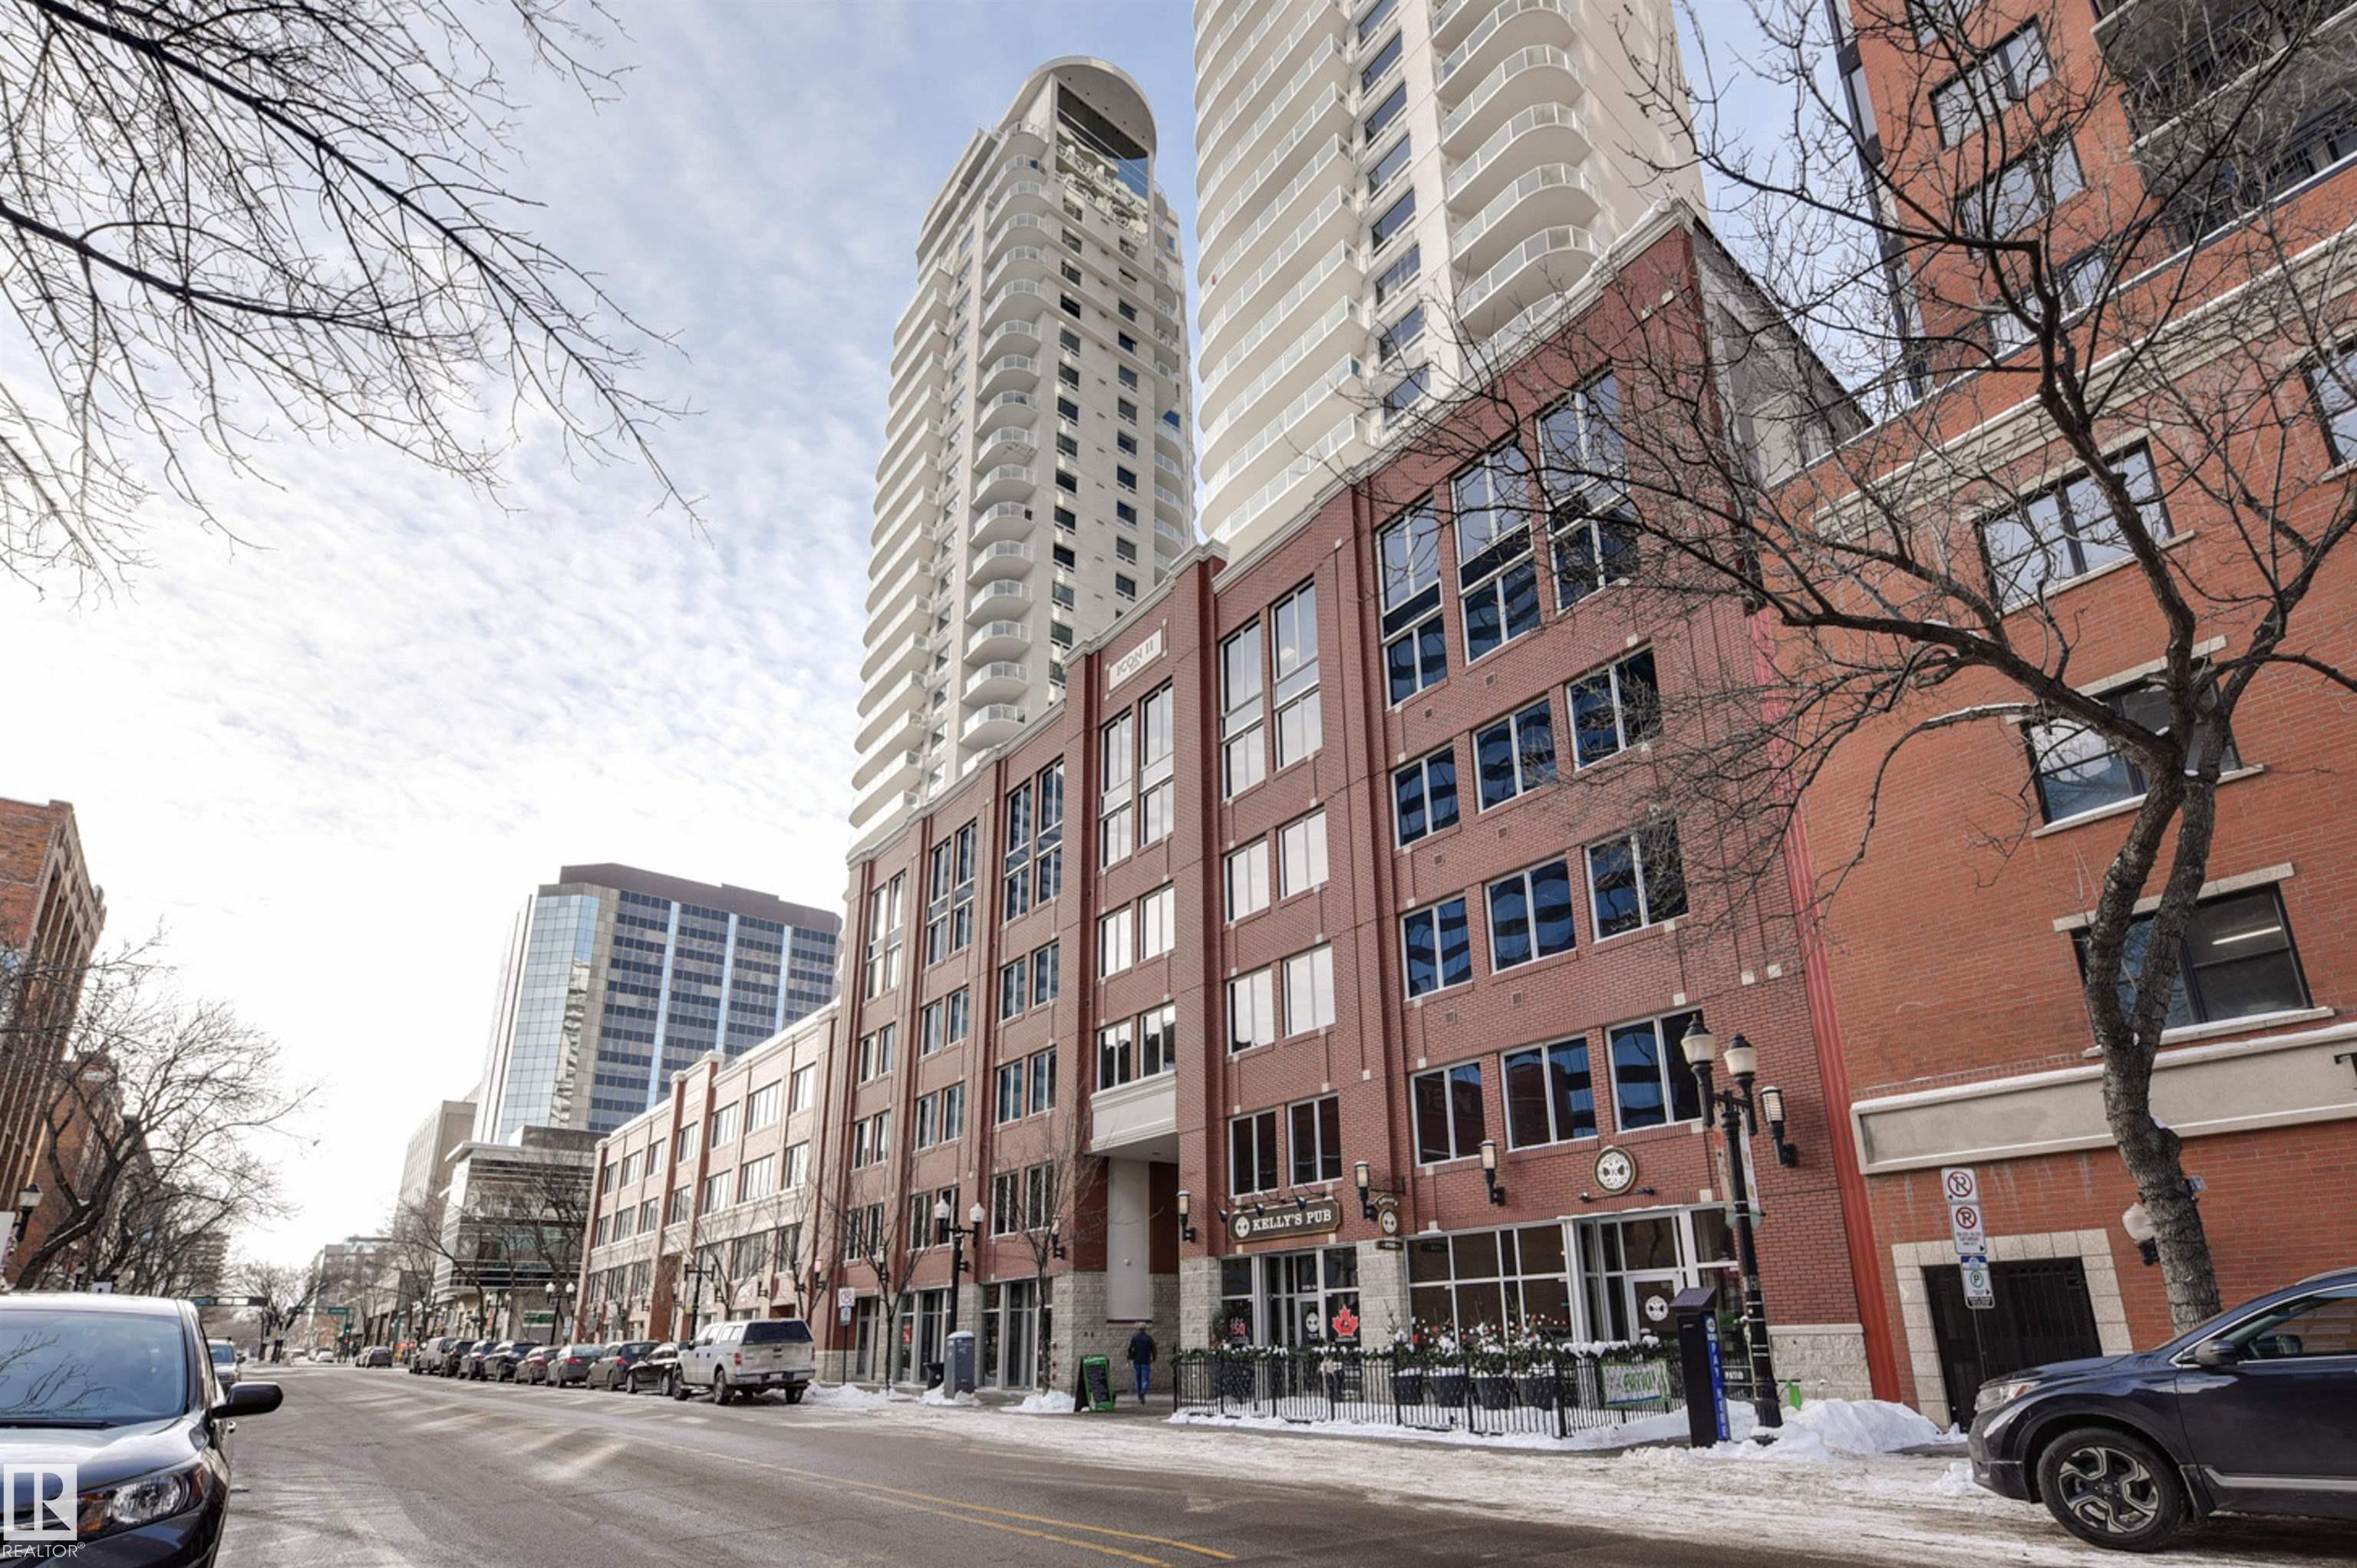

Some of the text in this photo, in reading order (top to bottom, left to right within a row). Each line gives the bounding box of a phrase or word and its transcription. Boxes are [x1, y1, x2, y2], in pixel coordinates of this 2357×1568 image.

[1117, 648, 1142, 676] ICON
[1252, 1210, 1332, 1231] KELLY'S PUB
